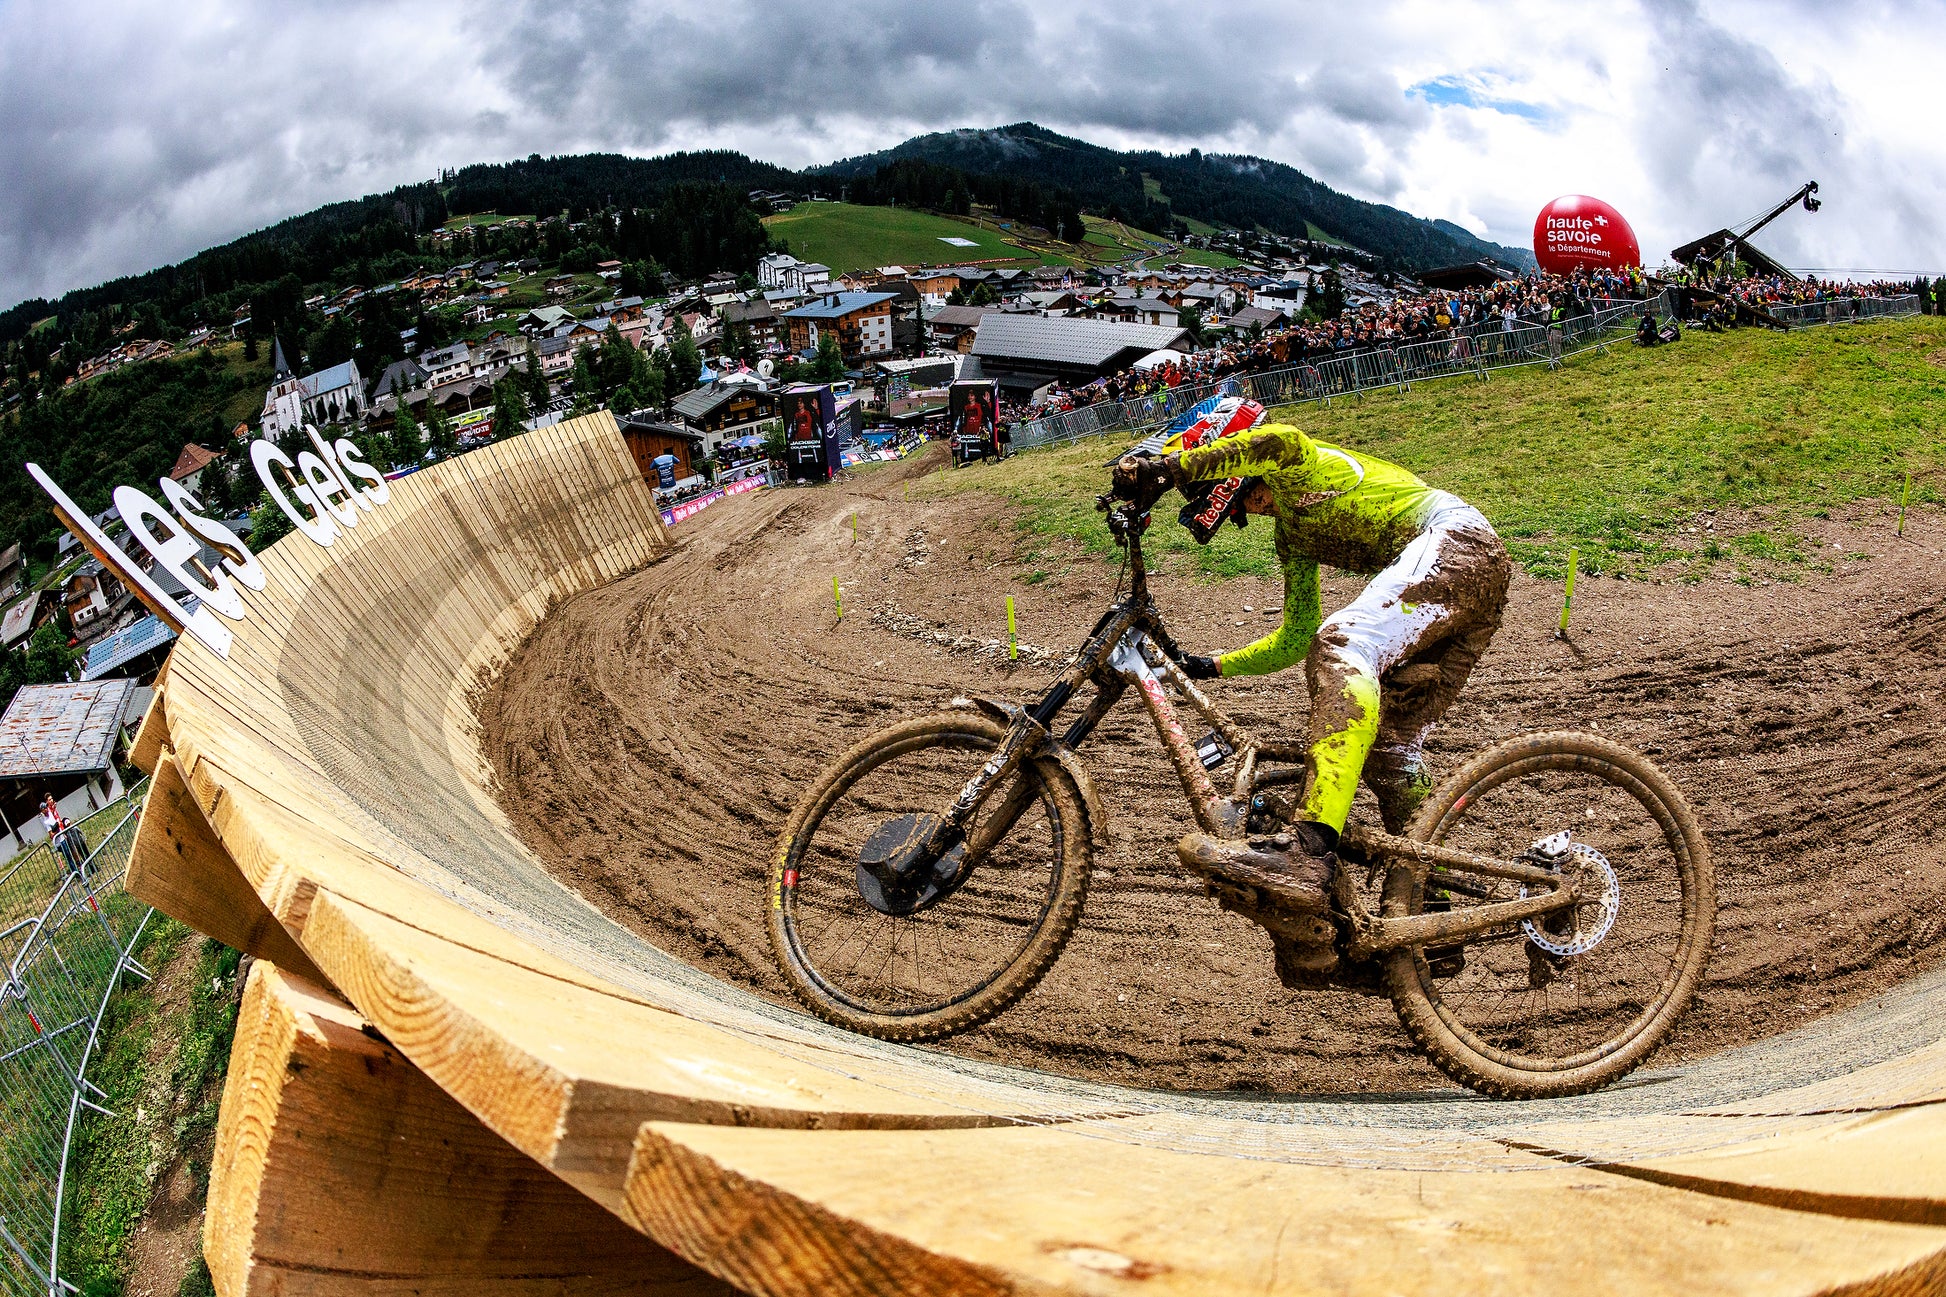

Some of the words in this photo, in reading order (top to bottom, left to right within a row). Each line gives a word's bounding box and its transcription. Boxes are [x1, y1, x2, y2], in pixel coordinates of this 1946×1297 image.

[1546, 214, 1593, 230] haute
[1547, 230, 1602, 245] savoie
[1548, 244, 1556, 252] le
[1557, 243, 1611, 258] Département
[250, 423, 390, 548] Gets
[1194, 494, 1228, 530] Red
